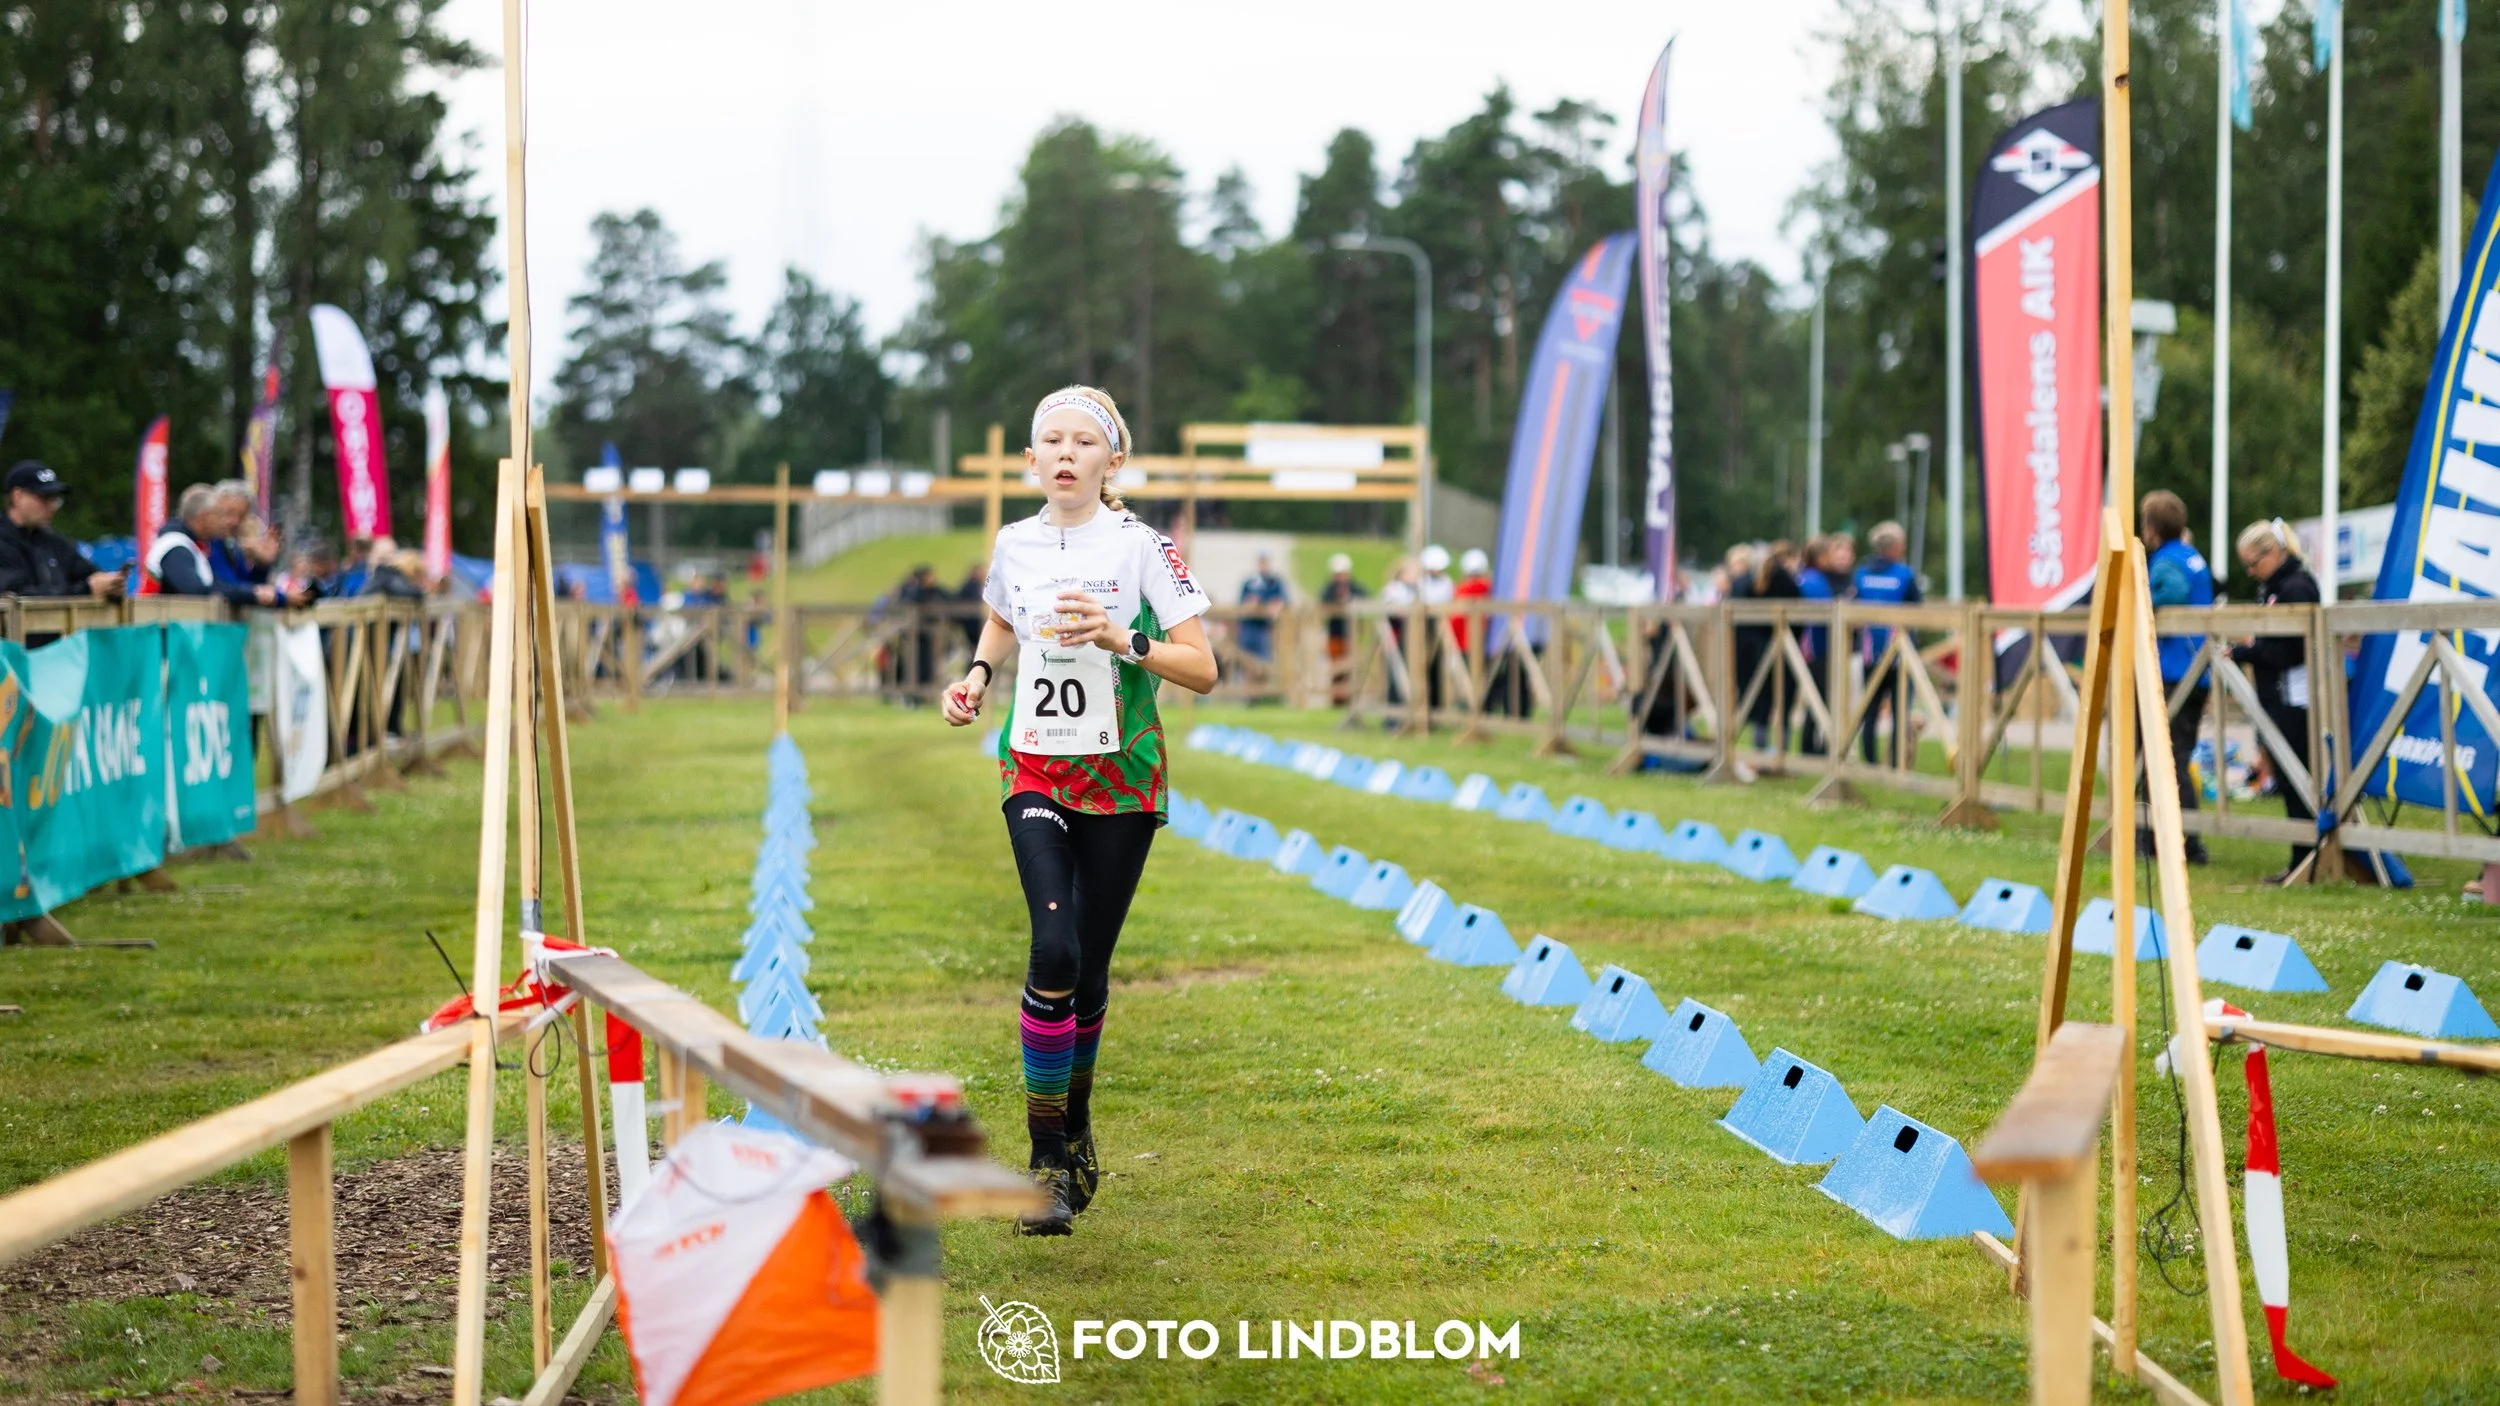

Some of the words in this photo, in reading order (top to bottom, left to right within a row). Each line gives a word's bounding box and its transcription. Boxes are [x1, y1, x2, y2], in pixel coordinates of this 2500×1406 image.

[2020, 235, 2056, 321] AIK
[2025, 329, 2064, 588] Sävedalens
[1081, 580, 1105, 588] INGE
[1107, 579, 1119, 588] SK
[1034, 678, 1086, 717] 20
[1099, 731, 1109, 745] 8
[1022, 807, 1068, 833] TRIMTEX
